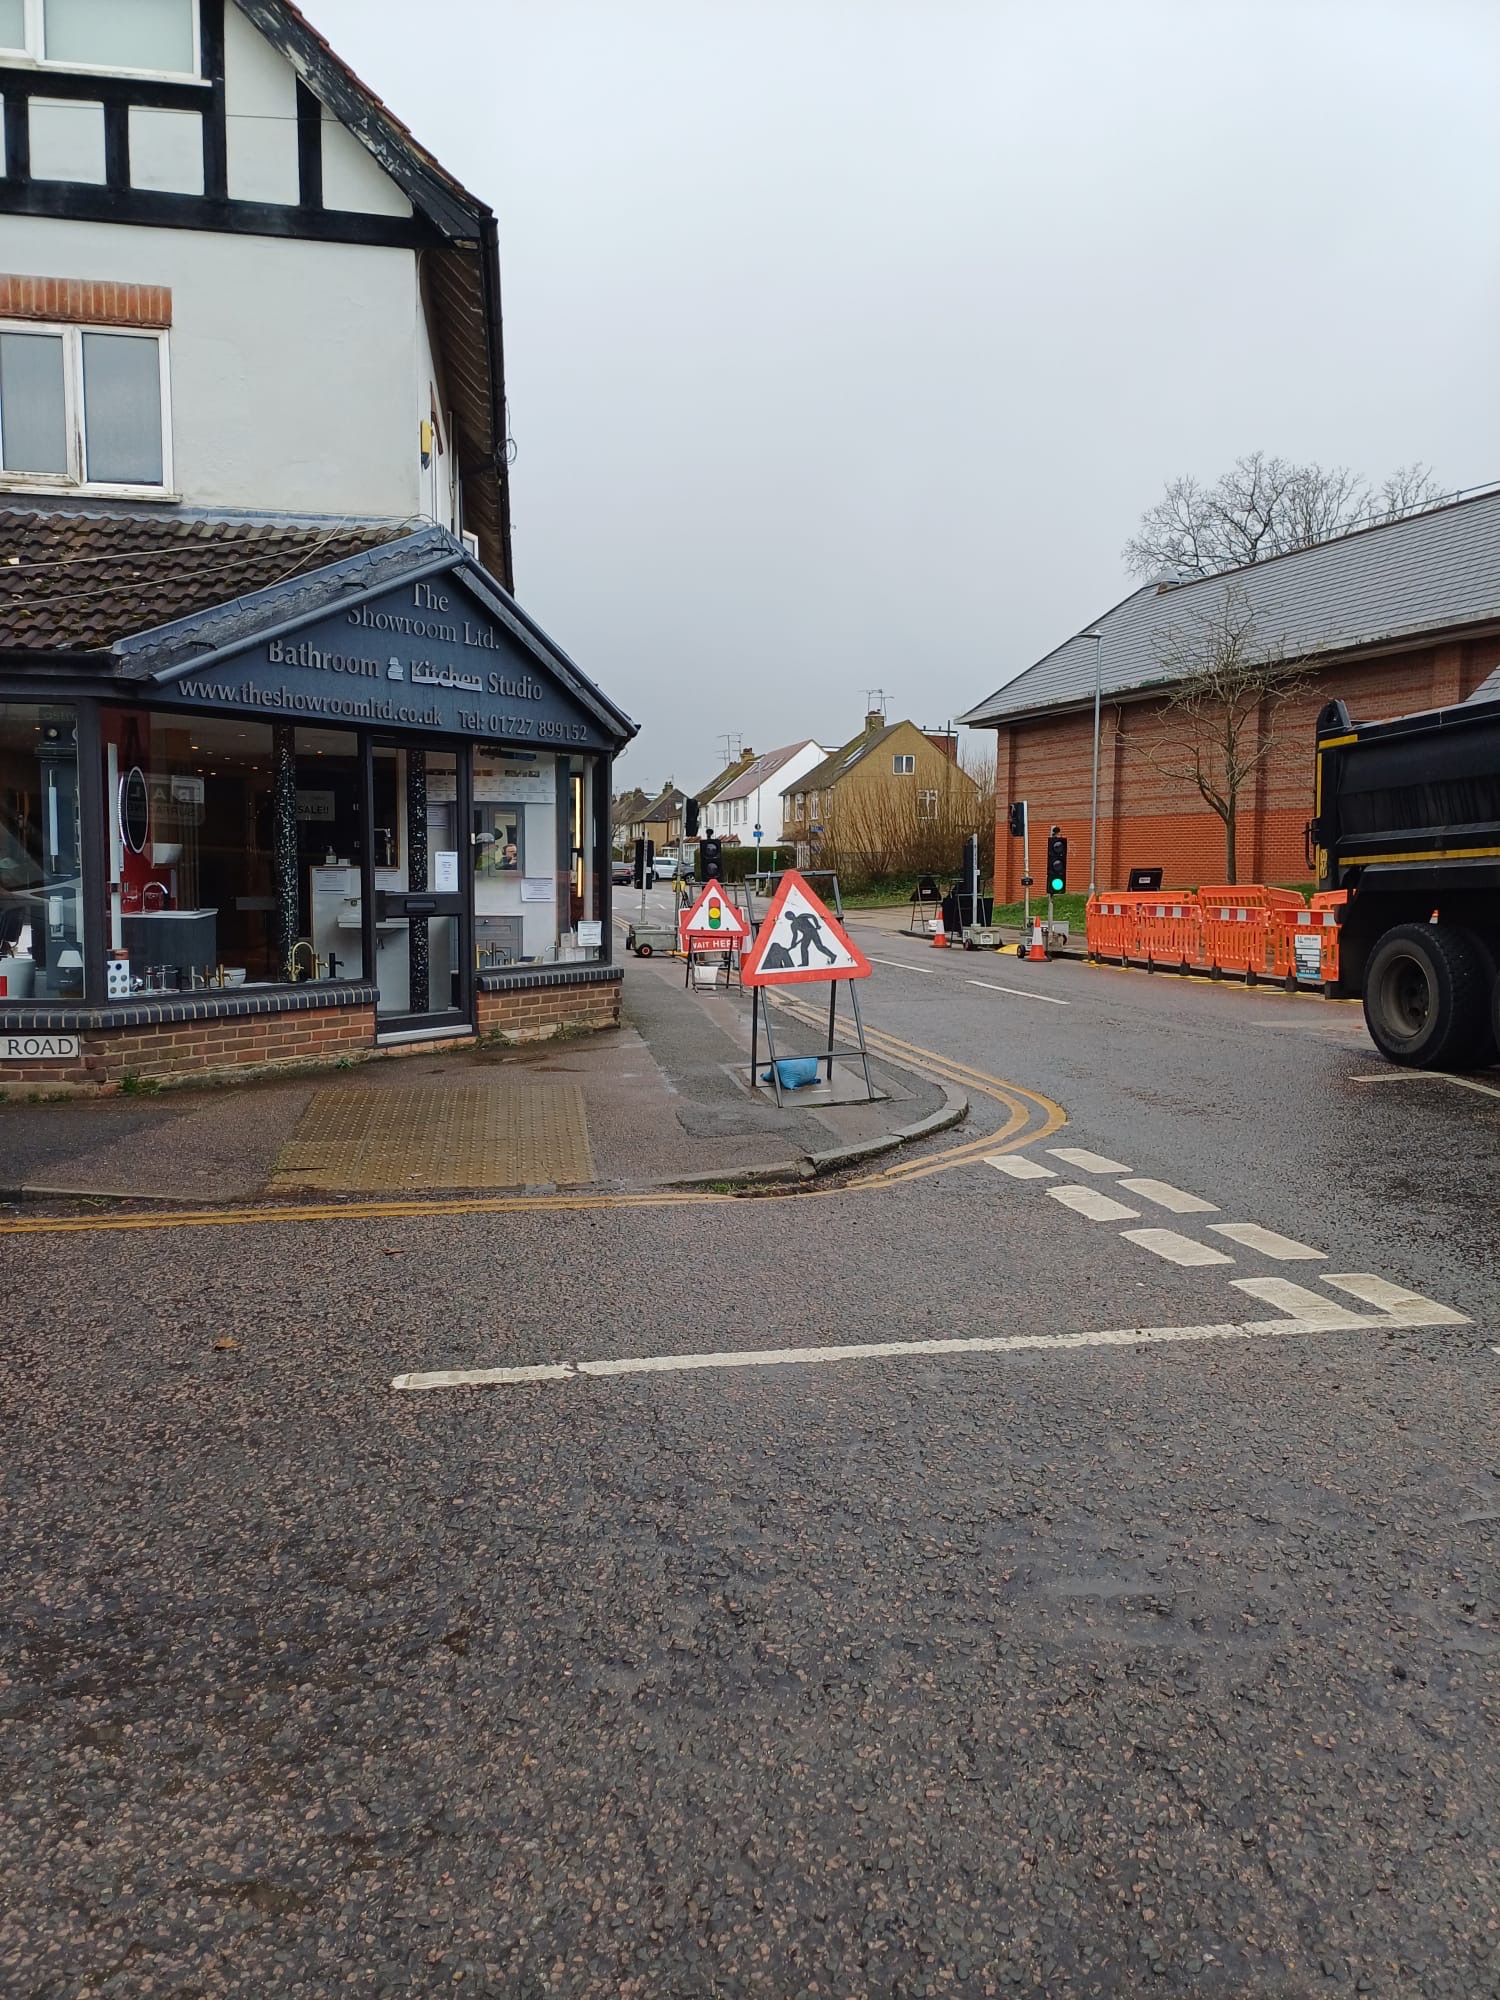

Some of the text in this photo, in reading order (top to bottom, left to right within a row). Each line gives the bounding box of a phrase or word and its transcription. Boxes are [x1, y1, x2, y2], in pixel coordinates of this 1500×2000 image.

[413, 583, 449, 611] The
[348, 605, 500, 649] Showroom Ltd.
[269, 640, 380, 677] Bathroom
[411, 659, 483, 691] Kitchen
[488, 671, 543, 700] Studio
[178, 680, 588, 741] www.theshowroomltd.co.uk Tel: 01727 899152
[7, 1038, 74, 1056] ROAD
